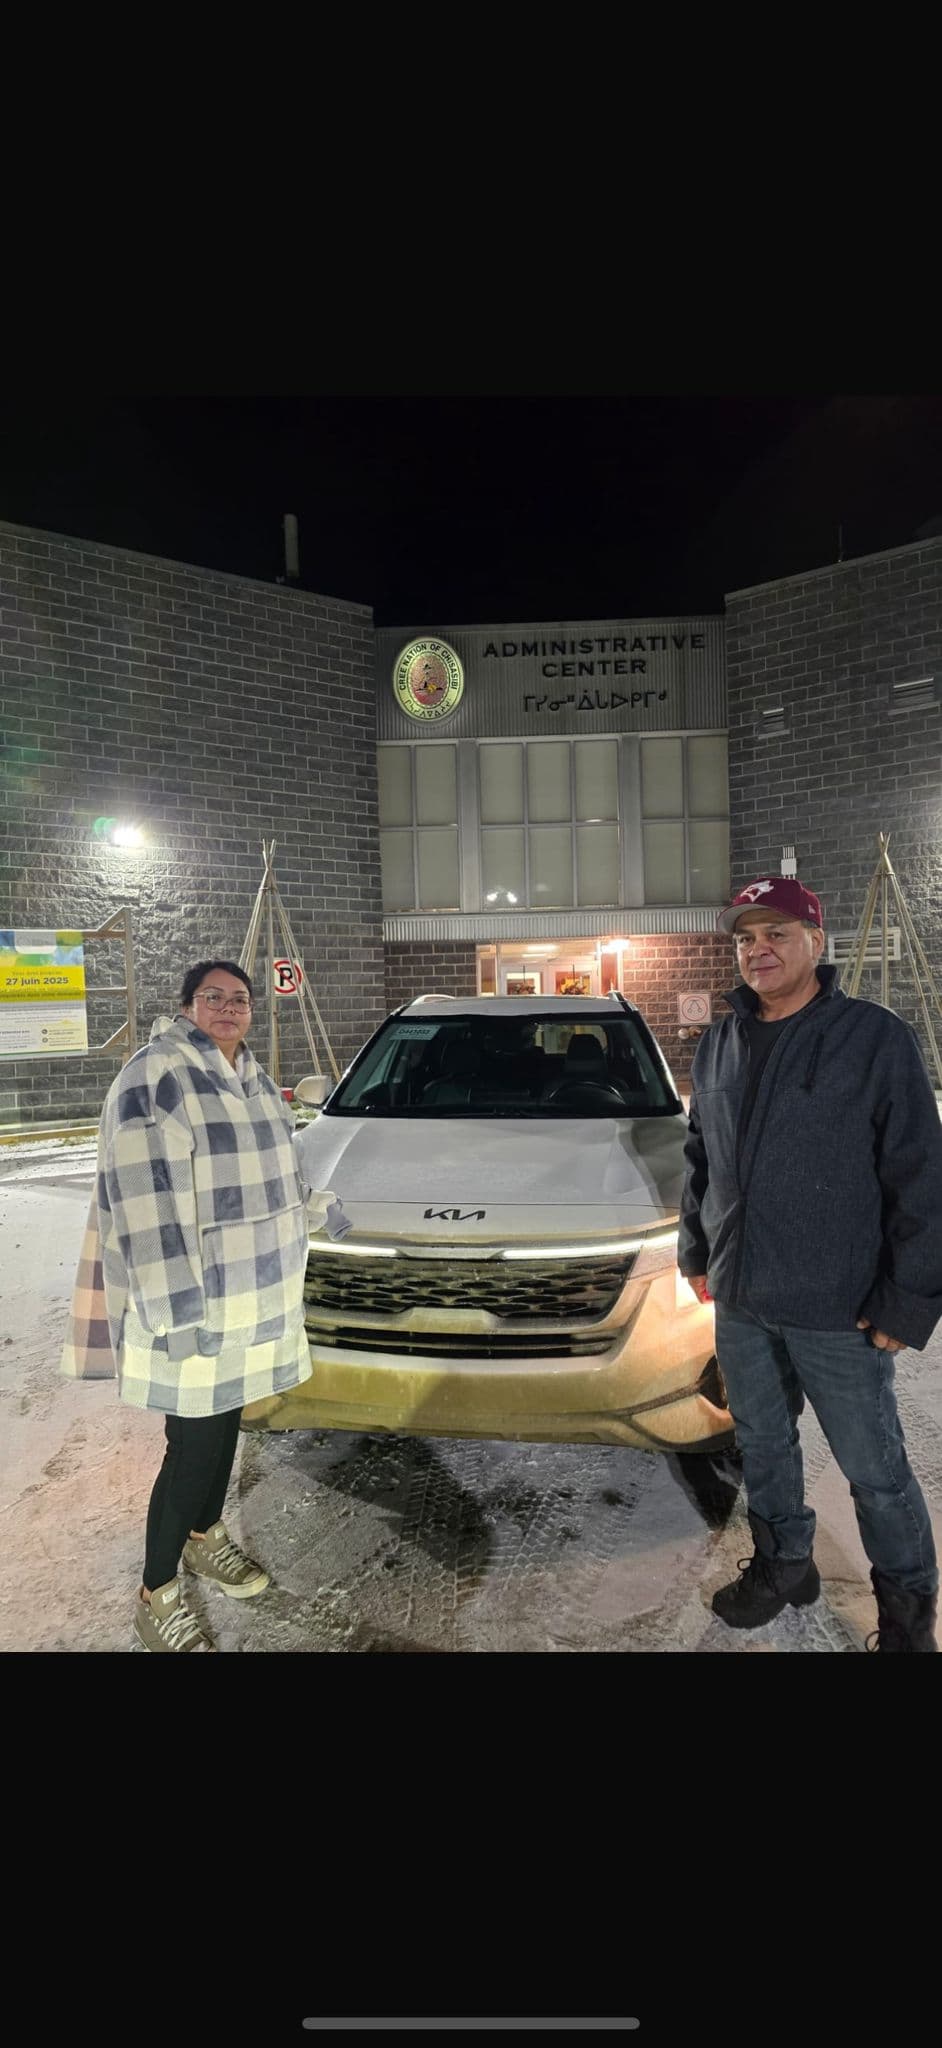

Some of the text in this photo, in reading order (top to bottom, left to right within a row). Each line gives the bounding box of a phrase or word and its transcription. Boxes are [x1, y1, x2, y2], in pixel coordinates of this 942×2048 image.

[482, 634, 705, 658] ADMINISTRATIVE
[403, 643, 427, 666] NATION
[430, 643, 441, 652] OF
[441, 650, 459, 690] CHISASIBI
[542, 659, 647, 677] CENTER
[6, 976, 69, 986] 27 juin 2025
[280, 967, 293, 986] P
